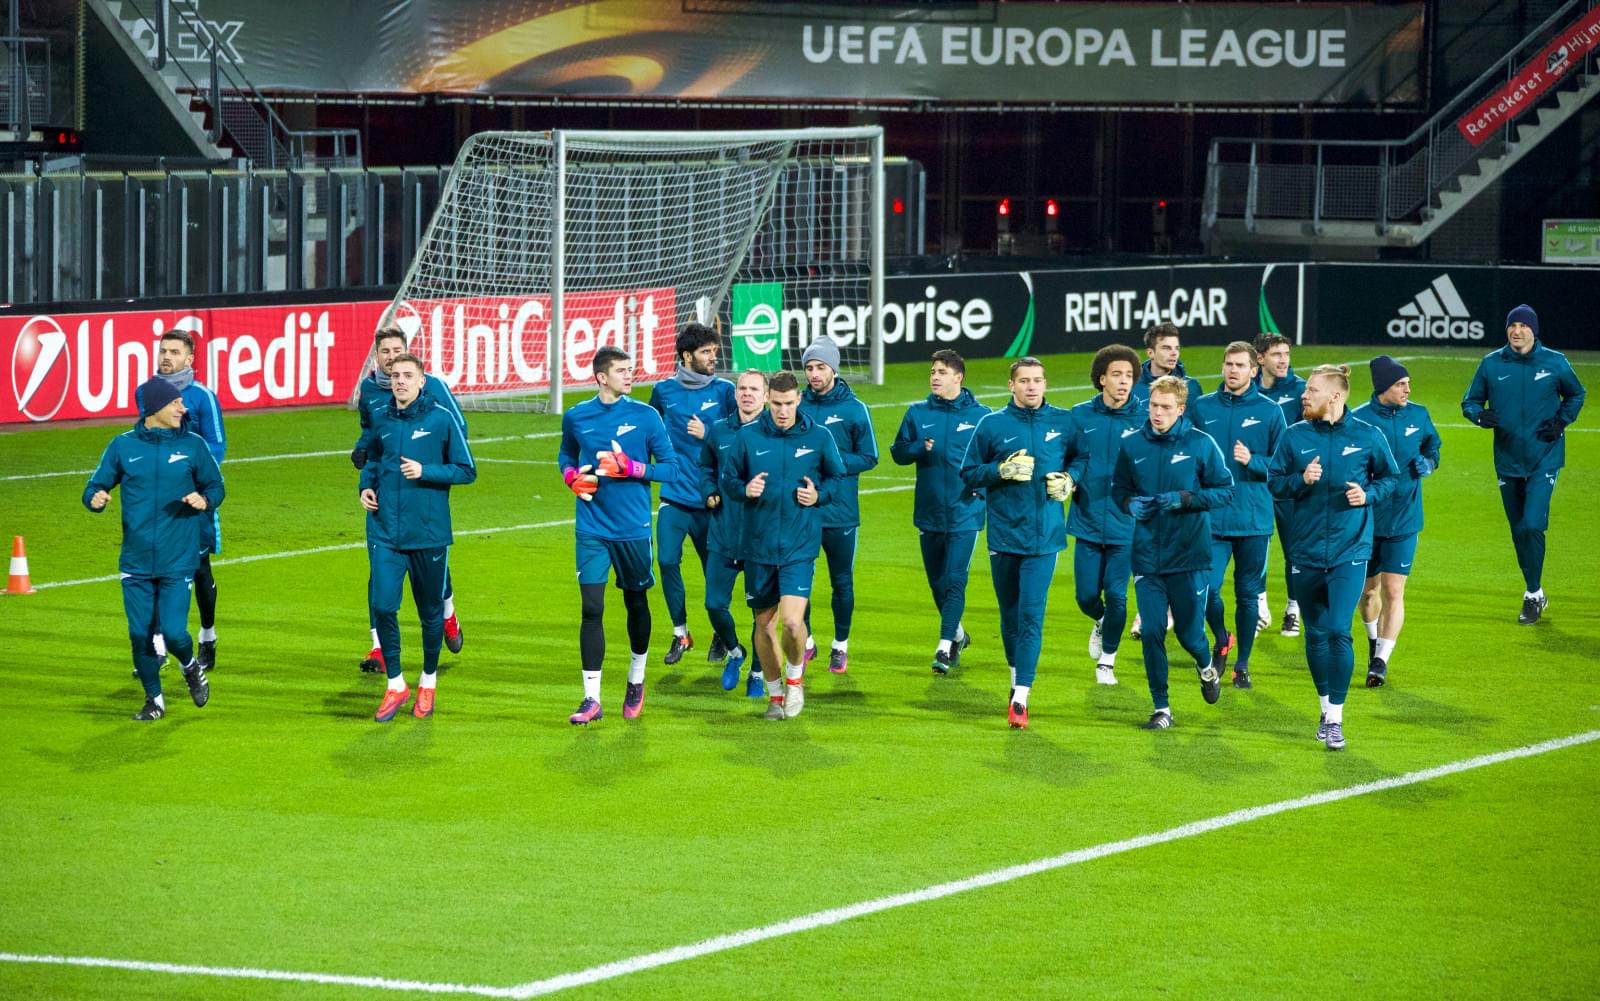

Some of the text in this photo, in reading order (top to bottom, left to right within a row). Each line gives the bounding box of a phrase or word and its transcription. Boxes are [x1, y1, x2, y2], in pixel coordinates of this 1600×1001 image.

[802, 25, 1346, 67] UEFA EUROPA LEAGUE
[1466, 72, 1543, 136] Retteketet
[732, 285, 992, 355] enterprise
[1065, 287, 1228, 333] RENT-A-CAR
[1386, 315, 1485, 341] adidas
[431, 295, 659, 386] UniCedit
